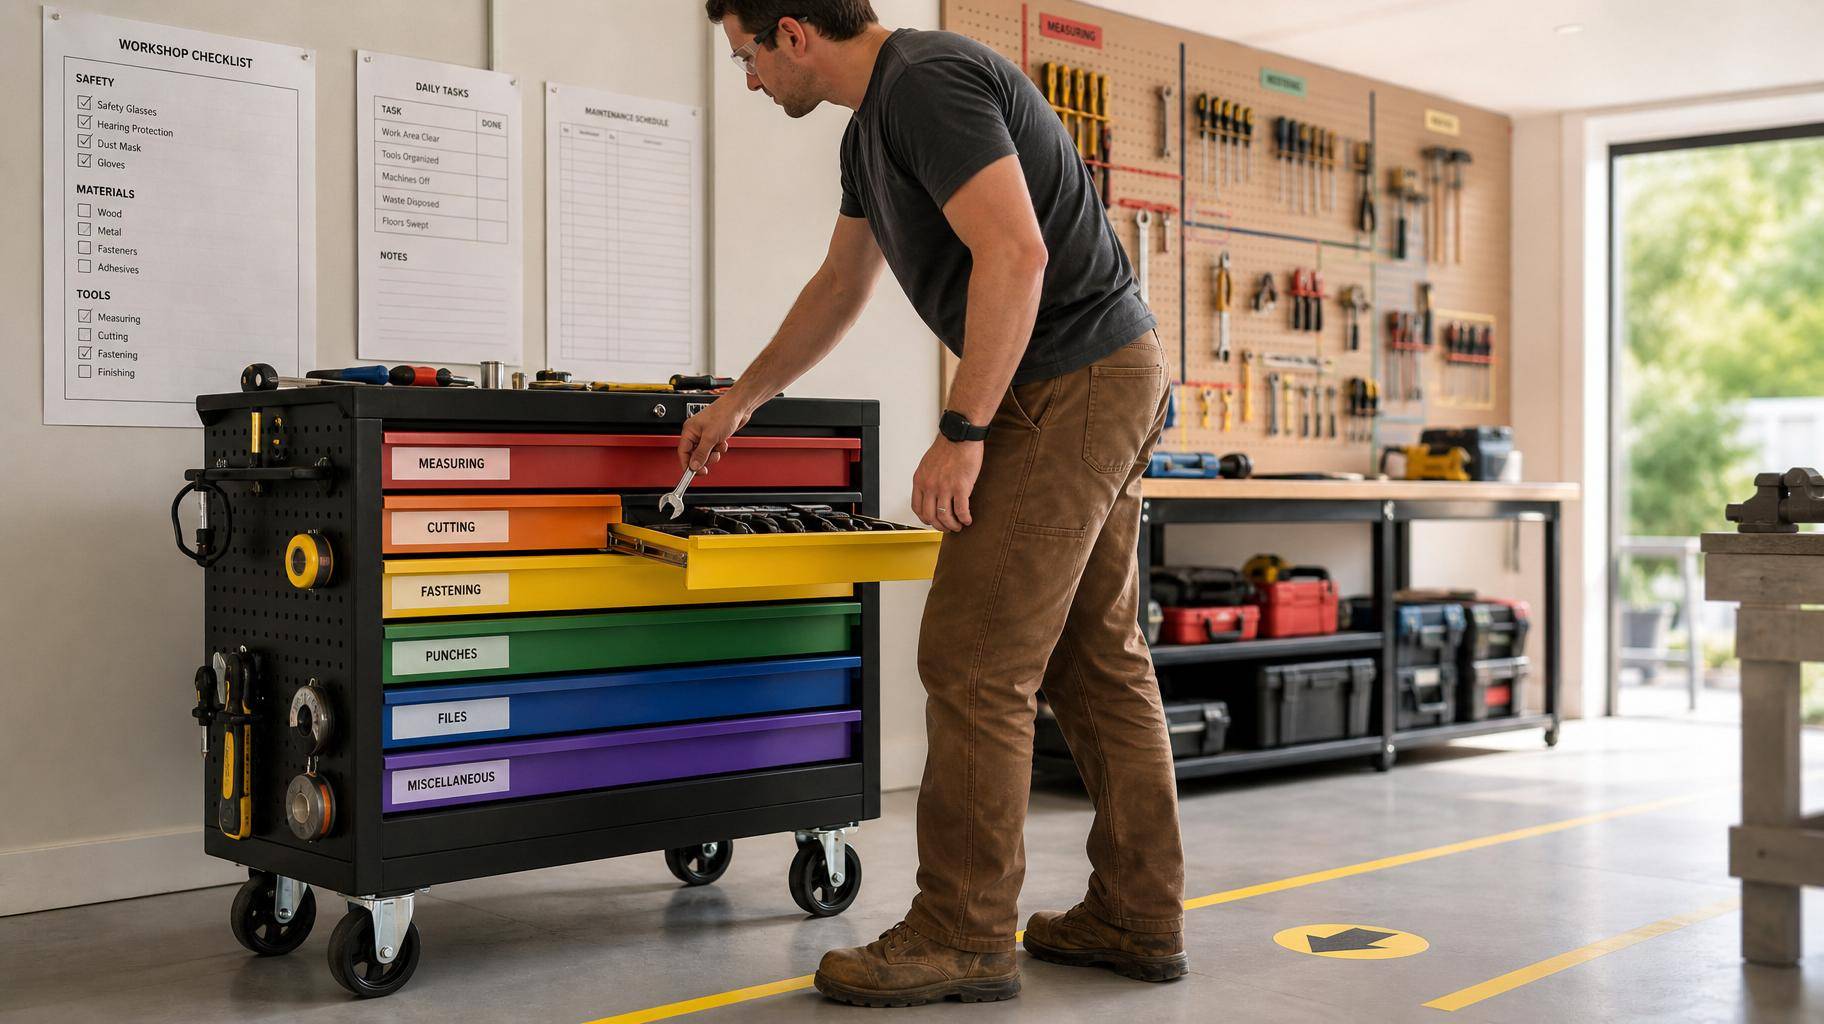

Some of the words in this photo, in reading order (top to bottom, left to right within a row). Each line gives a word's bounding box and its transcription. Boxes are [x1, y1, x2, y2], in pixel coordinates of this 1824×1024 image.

[119, 38, 189, 59] WORKSHOP
[192, 50, 253, 69] CHECKLIST
[76, 73, 114, 87] SAFETY
[416, 82, 440, 95] DAILY
[443, 86, 469, 98] TASKS
[97, 100, 124, 114] Safety
[126, 104, 157, 117] Glasses
[381, 105, 402, 116] TASK
[585, 107, 633, 122] MAINTENANCE
[635, 115, 670, 127] SCHEDULE
[97, 120, 130, 134] Hearing
[132, 124, 174, 138] Protection
[482, 119, 502, 130] DONE
[381, 127, 401, 138] Work
[403, 131, 420, 141] Area
[421, 133, 440, 143] Clear
[97, 139, 117, 151] Dust
[119, 141, 142, 153] Mask
[97, 158, 126, 170] Gloves
[382, 150, 401, 160] Tools
[402, 152, 440, 165] Organized
[382, 172, 417, 184] Machines
[419, 176, 430, 185] Off
[76, 184, 135, 199] MATERIALS
[382, 195, 406, 205] Waste
[407, 197, 440, 209] Disposed
[97, 207, 122, 219] Wood
[382, 216, 405, 228] Floors
[406, 219, 429, 230] Swept
[97, 226, 122, 237] Metal
[97, 244, 138, 256] Fasteners
[380, 251, 408, 261] NOTES
[97, 263, 140, 275] Adhesives
[76, 289, 111, 300] TOOLS
[97, 312, 141, 326] Measuring
[97, 331, 129, 343] Cutting
[97, 349, 138, 361] Fastening
[97, 367, 135, 380] Finishing
[418, 457, 485, 469] MEASURING
[427, 521, 476, 533] CUTTING
[421, 584, 481, 597] FASTENING
[425, 648, 478, 662] PUNCHES
[438, 711, 467, 724] FILES
[407, 771, 495, 792] MISCELLANEOUS
